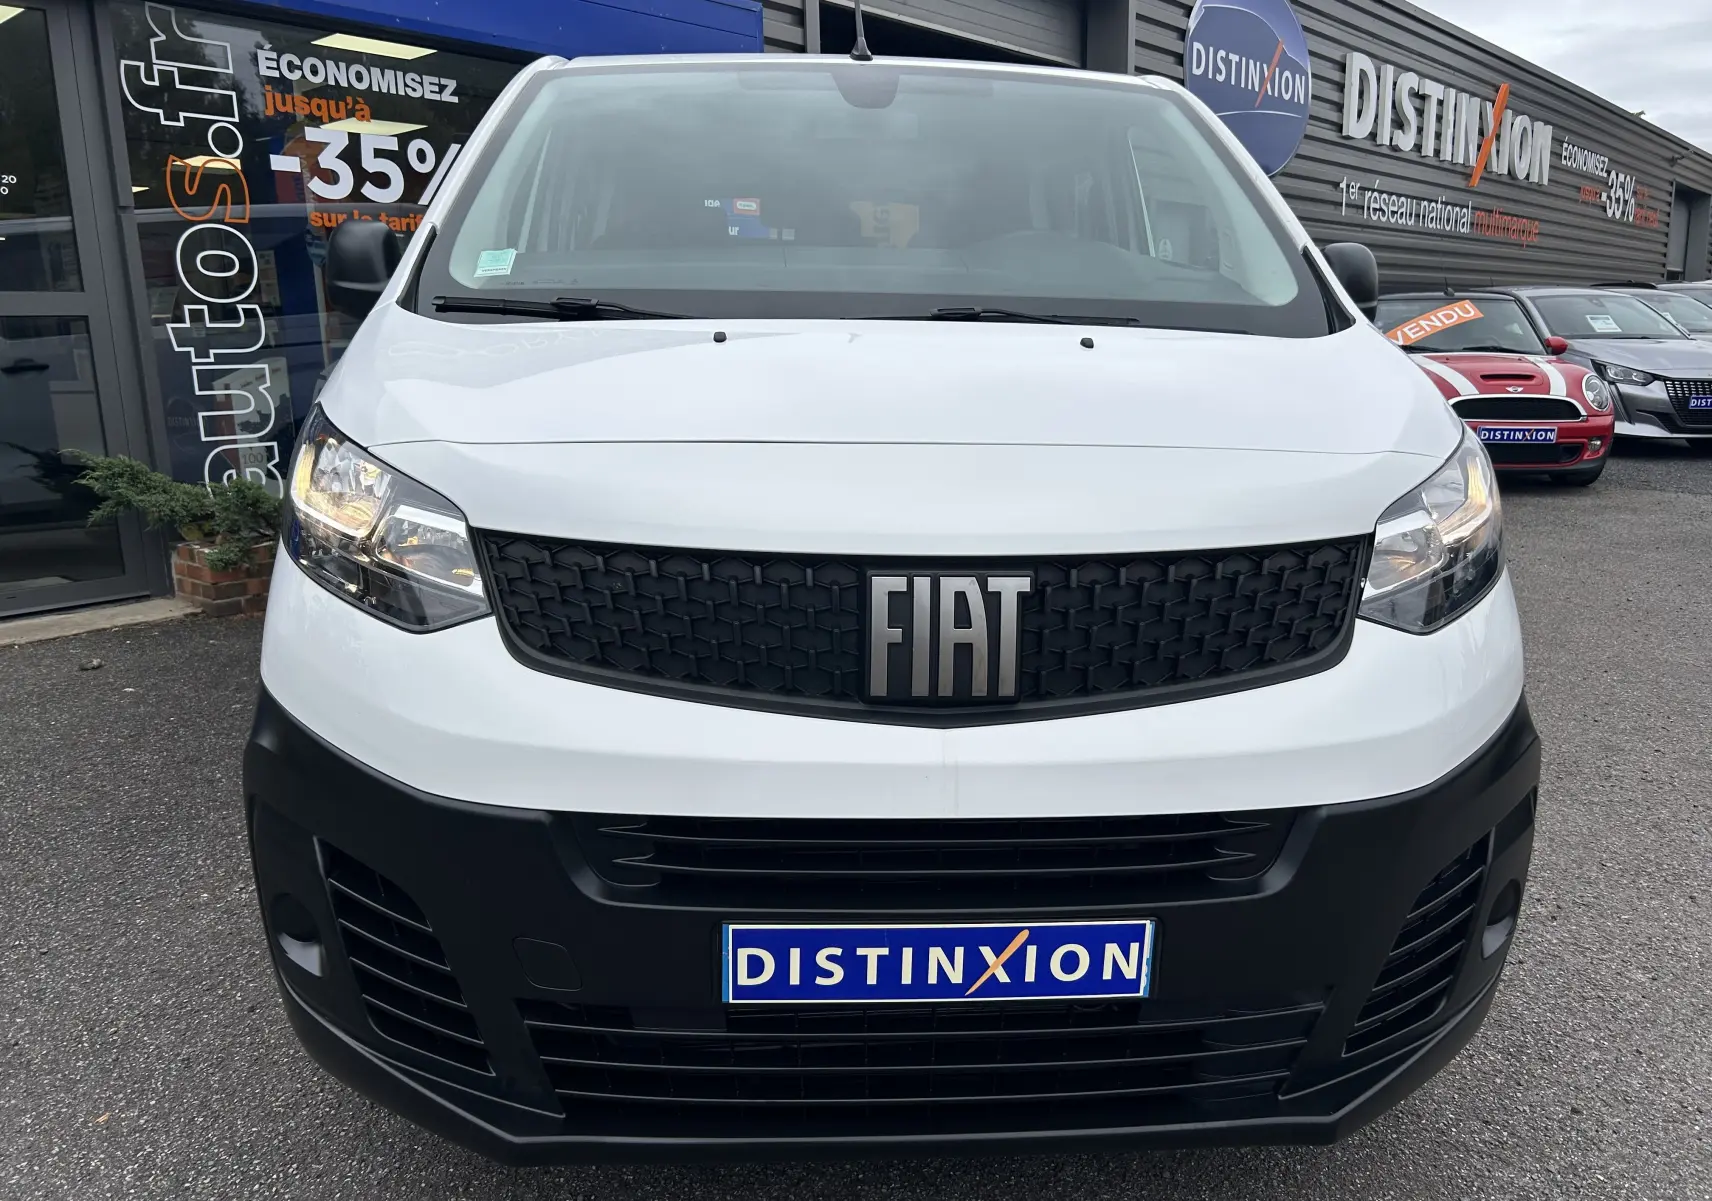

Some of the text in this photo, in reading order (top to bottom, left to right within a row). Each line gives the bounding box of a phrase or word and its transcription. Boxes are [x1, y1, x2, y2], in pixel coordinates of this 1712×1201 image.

[257, 44, 459, 103] ÉCONOMISEZ
[1192, 40, 1306, 107] DISTINXION
[264, 84, 371, 123] jusqu'à
[1342, 52, 1553, 187] DISTINXION
[1, 174, 17, 184] 20
[1561, 136, 1609, 178] ÉCONOMISEZ
[1364, 179, 1415, 226] réseau
[1419, 196, 1472, 234] national
[1474, 206, 1540, 248] multimarque
[1601, 170, 1635, 222] -35%
[1390, 304, 1475, 346] VENDU
[1480, 428, 1555, 441] DISTINXION
[870, 576, 1030, 697] FIAT
[737, 929, 1139, 996] DISTINXION
